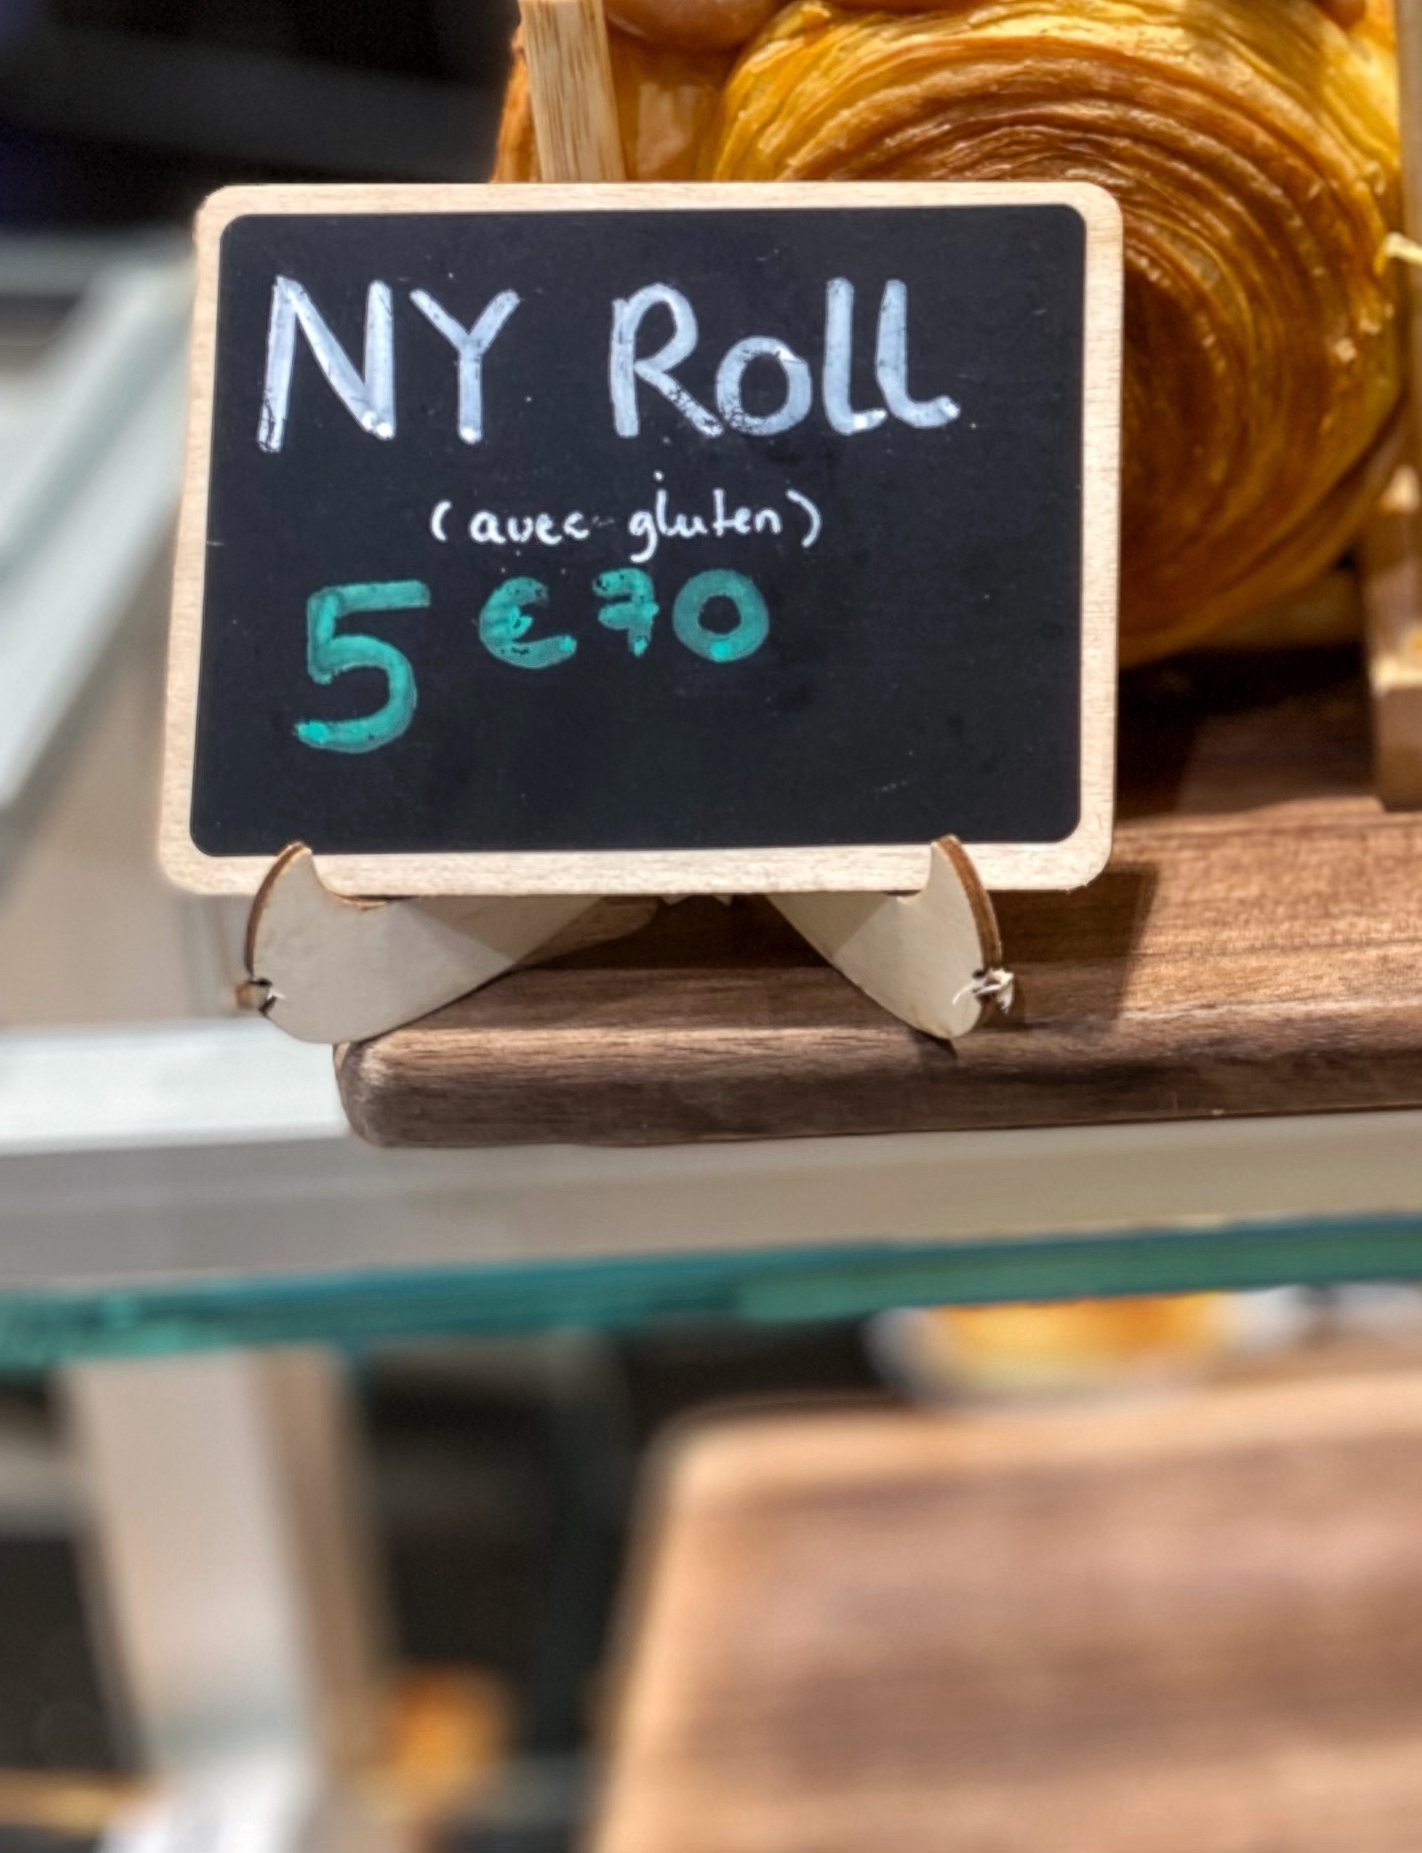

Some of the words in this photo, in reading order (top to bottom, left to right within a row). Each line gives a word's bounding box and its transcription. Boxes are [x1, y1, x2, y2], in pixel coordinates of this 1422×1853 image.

[256, 273, 521, 454] NY
[607, 276, 962, 439] Roll
[429, 499, 592, 547] (avec
[627, 485, 822, 564] gluten)
